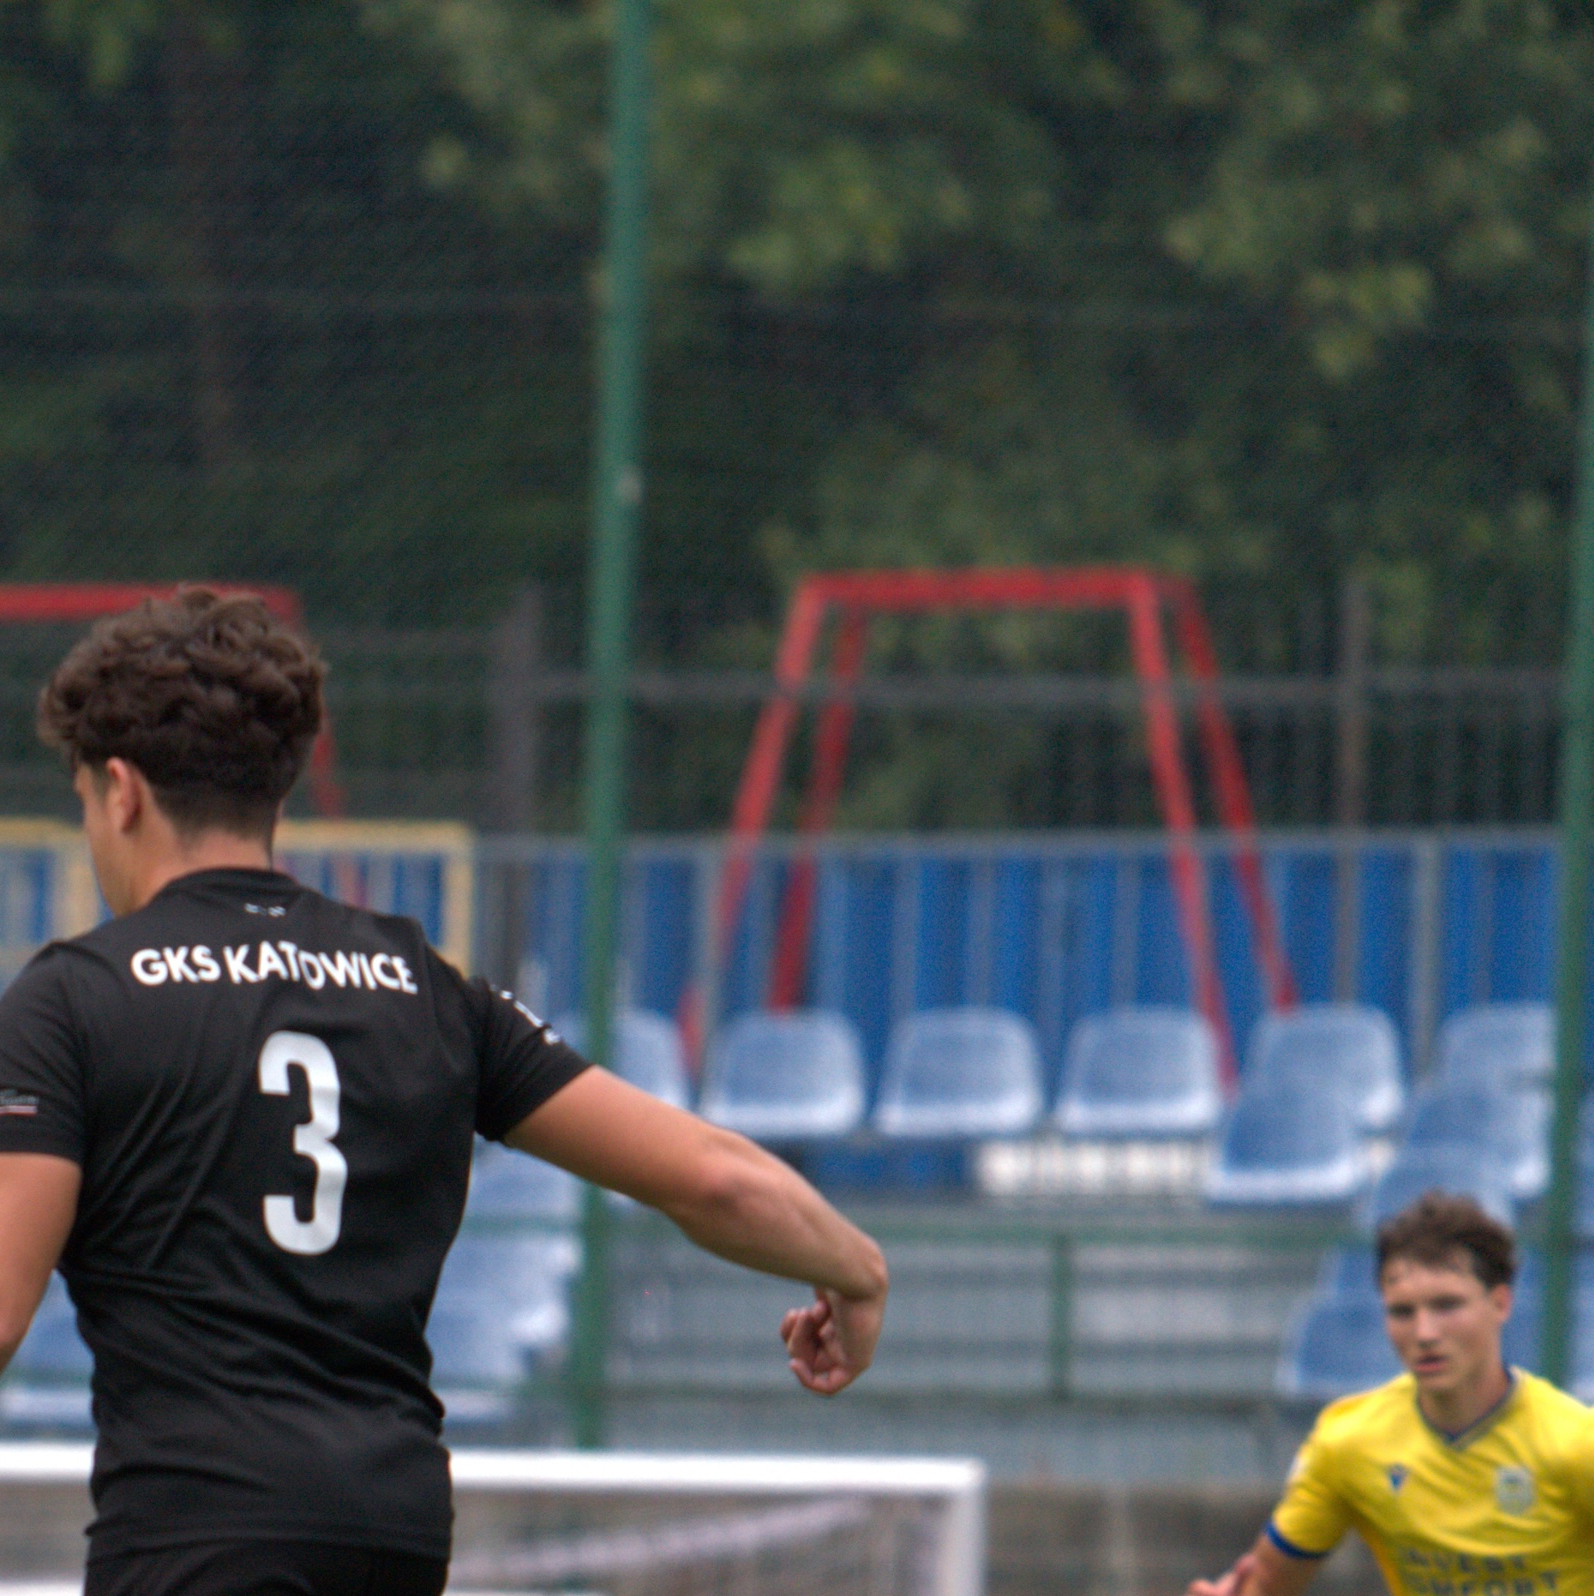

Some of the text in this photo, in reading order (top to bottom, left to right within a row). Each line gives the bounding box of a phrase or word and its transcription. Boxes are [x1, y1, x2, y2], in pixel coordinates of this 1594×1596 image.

[130, 940, 418, 995] GKS KATOWICE
[257, 1030, 348, 1255] 3
